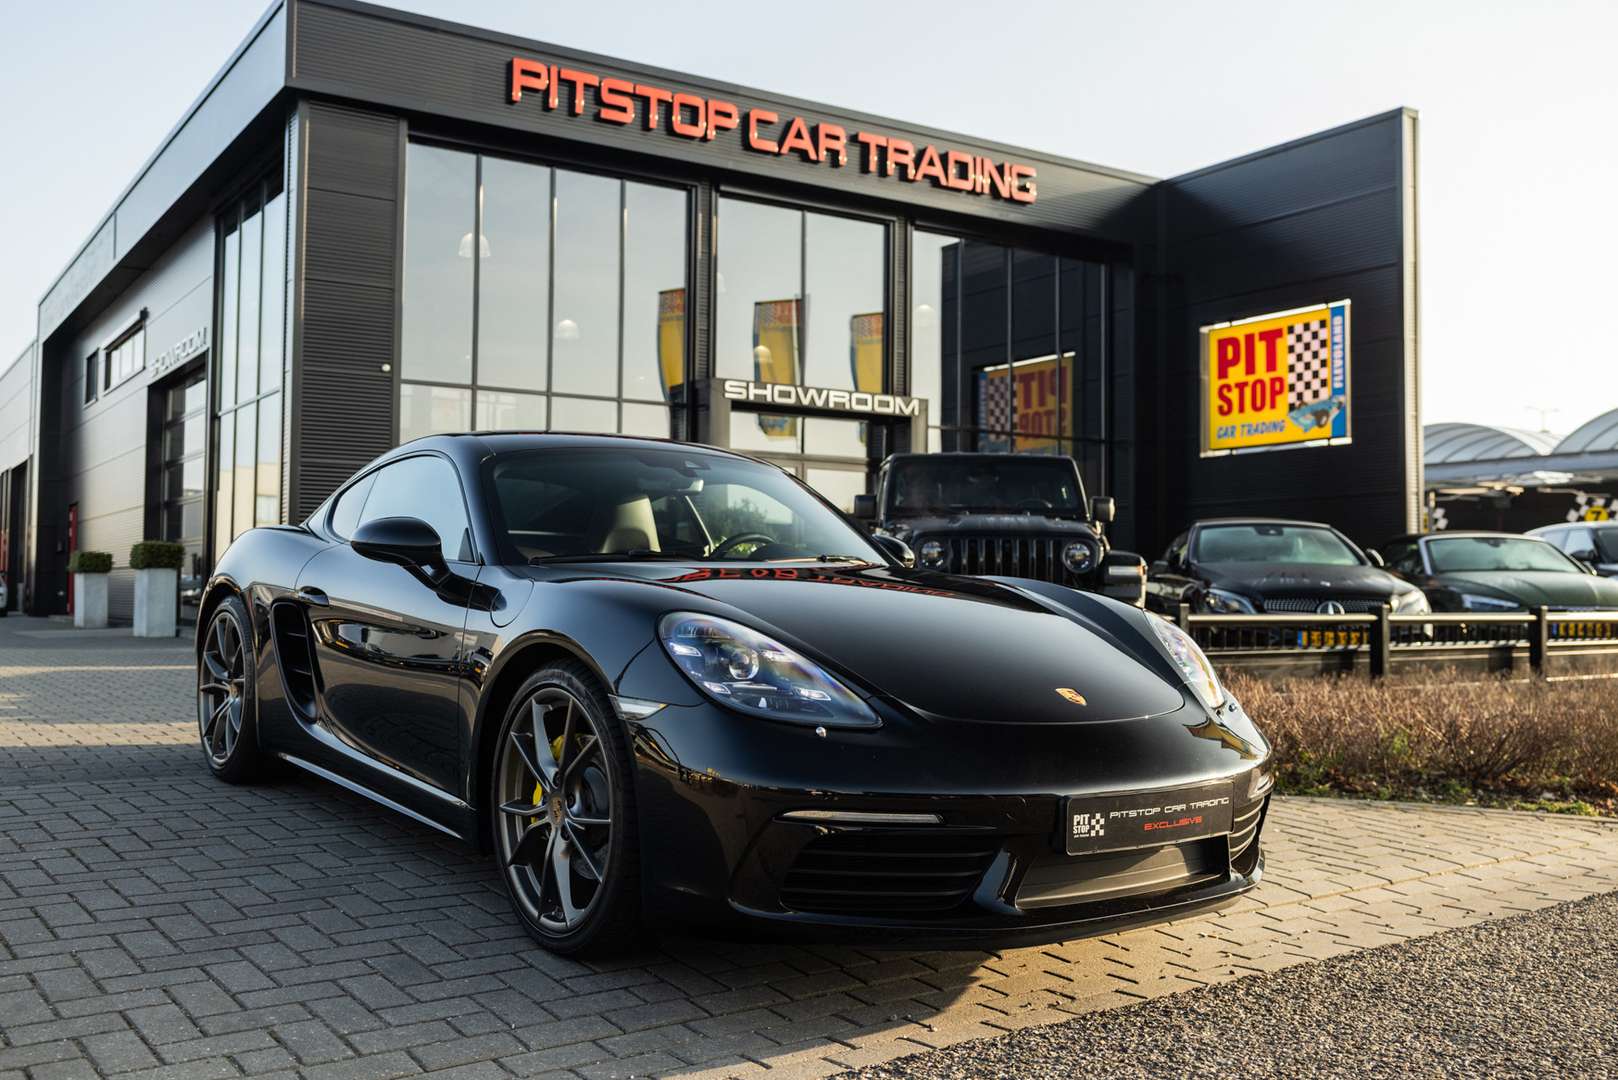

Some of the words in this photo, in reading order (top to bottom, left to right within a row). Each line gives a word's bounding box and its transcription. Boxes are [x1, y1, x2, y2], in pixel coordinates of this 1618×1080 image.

[511, 57, 740, 140] PITSTOP
[749, 108, 847, 167] CAR
[857, 131, 1037, 204] TRADING
[1217, 328, 1284, 380] PIT
[723, 380, 920, 416] SHOWROOM
[1217, 376, 1285, 417] STOP
[1216, 425, 1237, 440] CAR
[1240, 420, 1286, 437] TRADING
[1109, 807, 1161, 819] PITSTOP
[1164, 803, 1186, 813] CAR
[1189, 797, 1230, 809] TRADING
[1073, 813, 1090, 826] PIT
[1073, 824, 1090, 834] STOP
[1143, 815, 1203, 831] EXCLUSIVE
